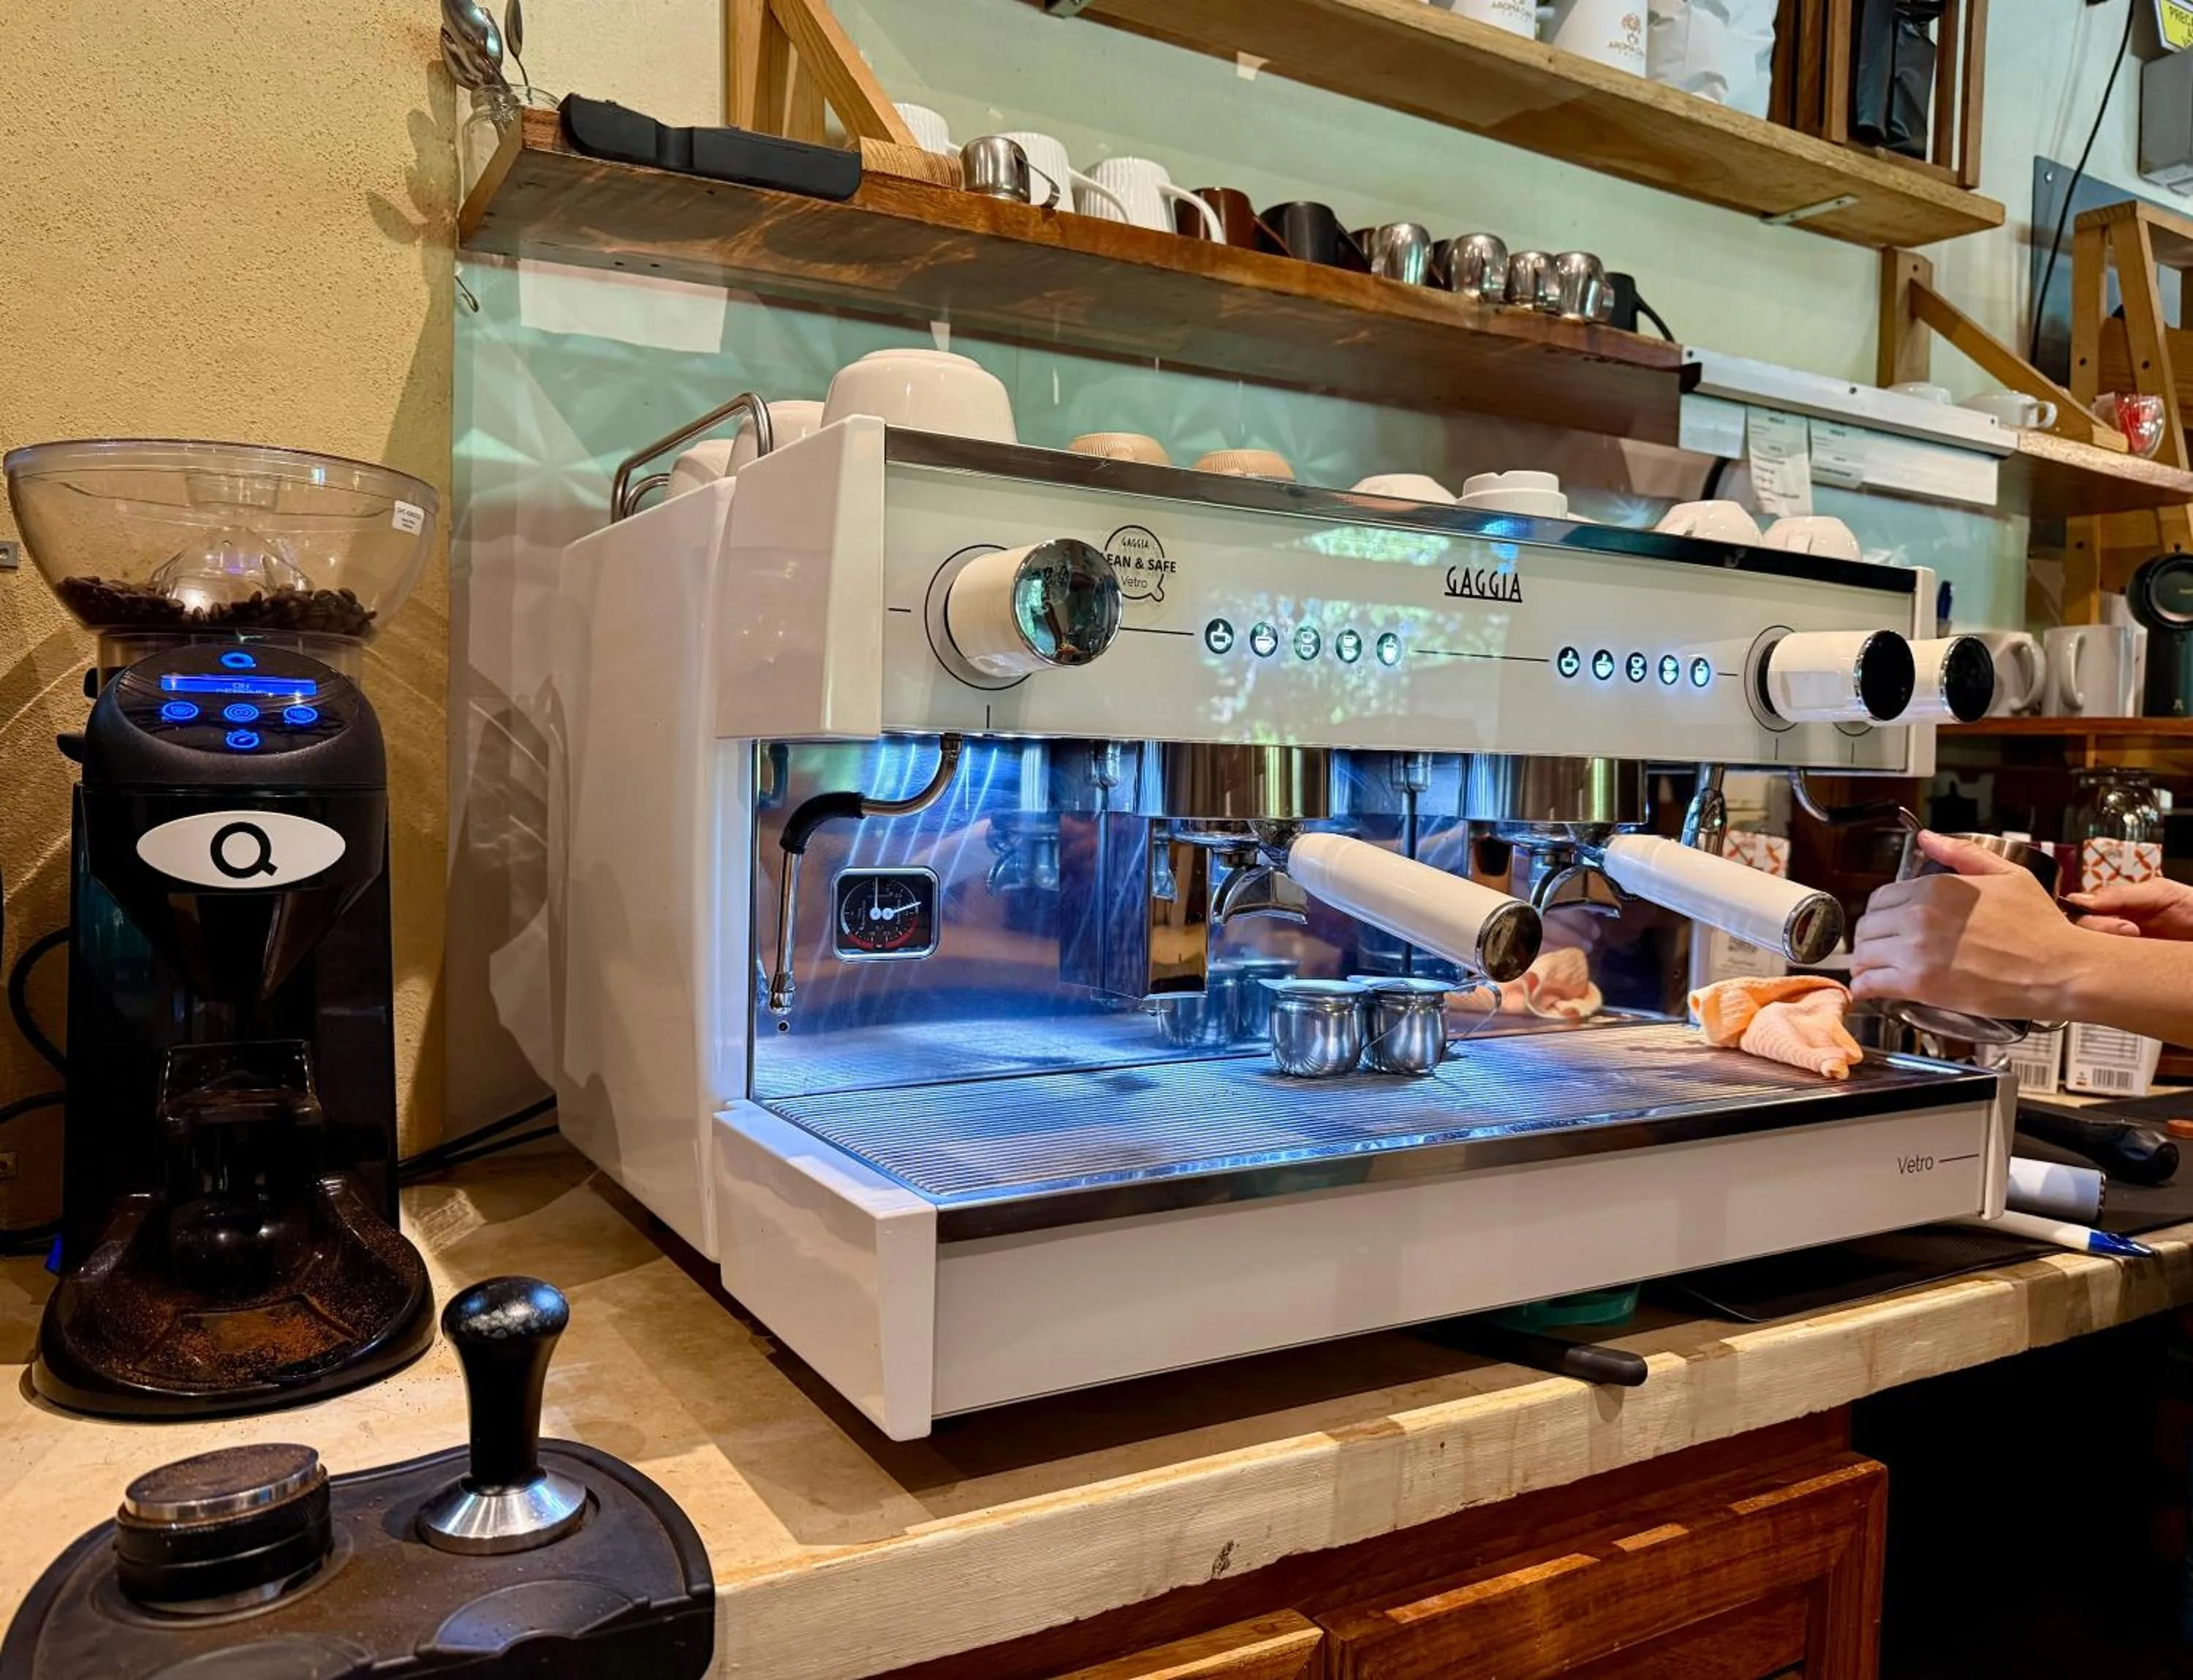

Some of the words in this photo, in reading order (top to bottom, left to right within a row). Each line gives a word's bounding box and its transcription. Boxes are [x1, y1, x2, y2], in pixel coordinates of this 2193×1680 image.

[1105, 553, 1131, 567] EAN
[1135, 556, 1145, 570] &
[1148, 559, 1177, 573] SAFE
[1121, 575, 1148, 589] Vetro
[1444, 565, 1523, 603] GAGGIA
[210, 821, 278, 879] Q
[1897, 1154, 1934, 1175] Vetro
